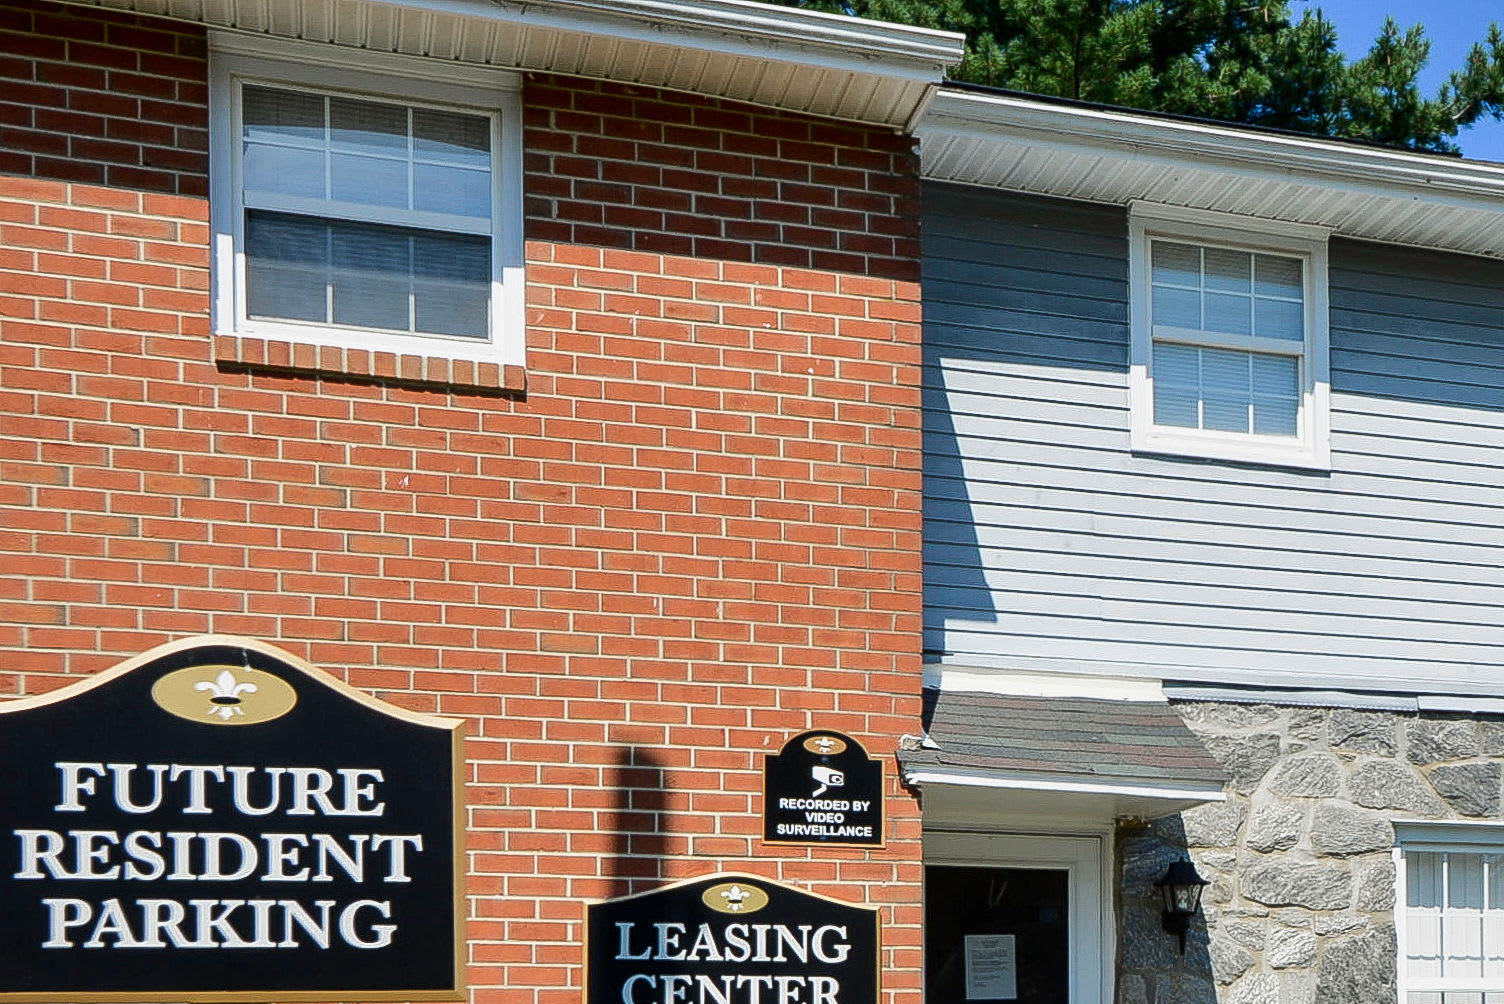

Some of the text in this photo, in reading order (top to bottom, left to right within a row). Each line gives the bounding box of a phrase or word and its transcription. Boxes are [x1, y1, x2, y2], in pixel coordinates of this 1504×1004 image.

[54, 762, 386, 816] FUTURE
[779, 797, 870, 812] RECORDED BY
[776, 823, 872, 837] SURVEILLANCE
[805, 812, 844, 824] VIDEO
[13, 829, 424, 883] RESIDENT
[41, 898, 398, 950] PARKING
[614, 922, 852, 964] LEASING
